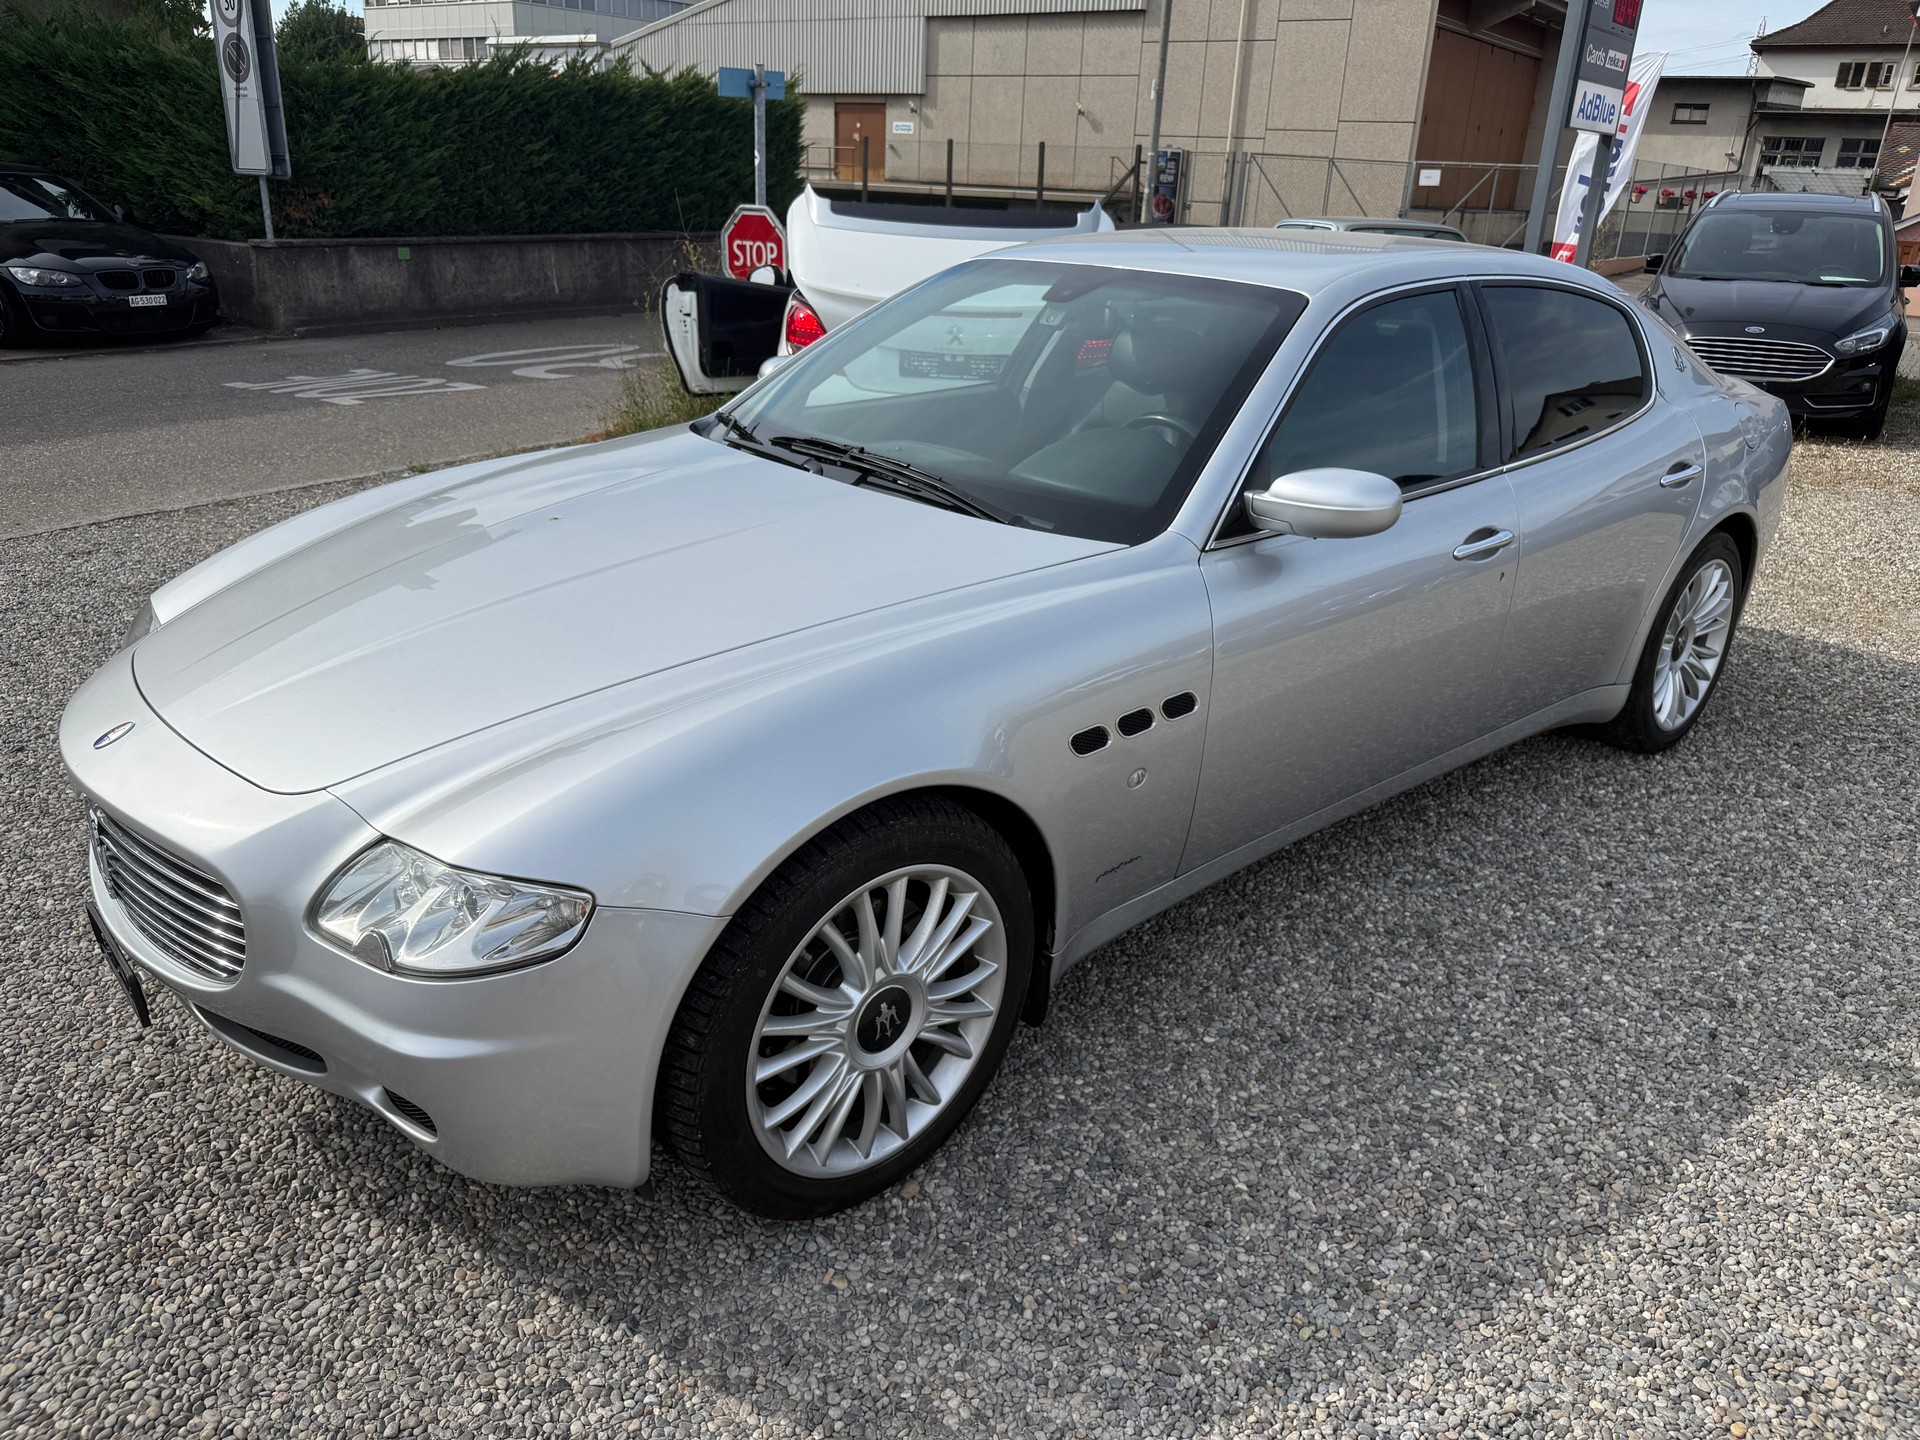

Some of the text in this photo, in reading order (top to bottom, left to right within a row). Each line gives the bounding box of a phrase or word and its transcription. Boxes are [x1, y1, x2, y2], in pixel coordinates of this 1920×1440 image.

[1587, 44, 1606, 66] Cards
[1576, 90, 1616, 125] AdBlue
[733, 240, 778, 267] STOP
